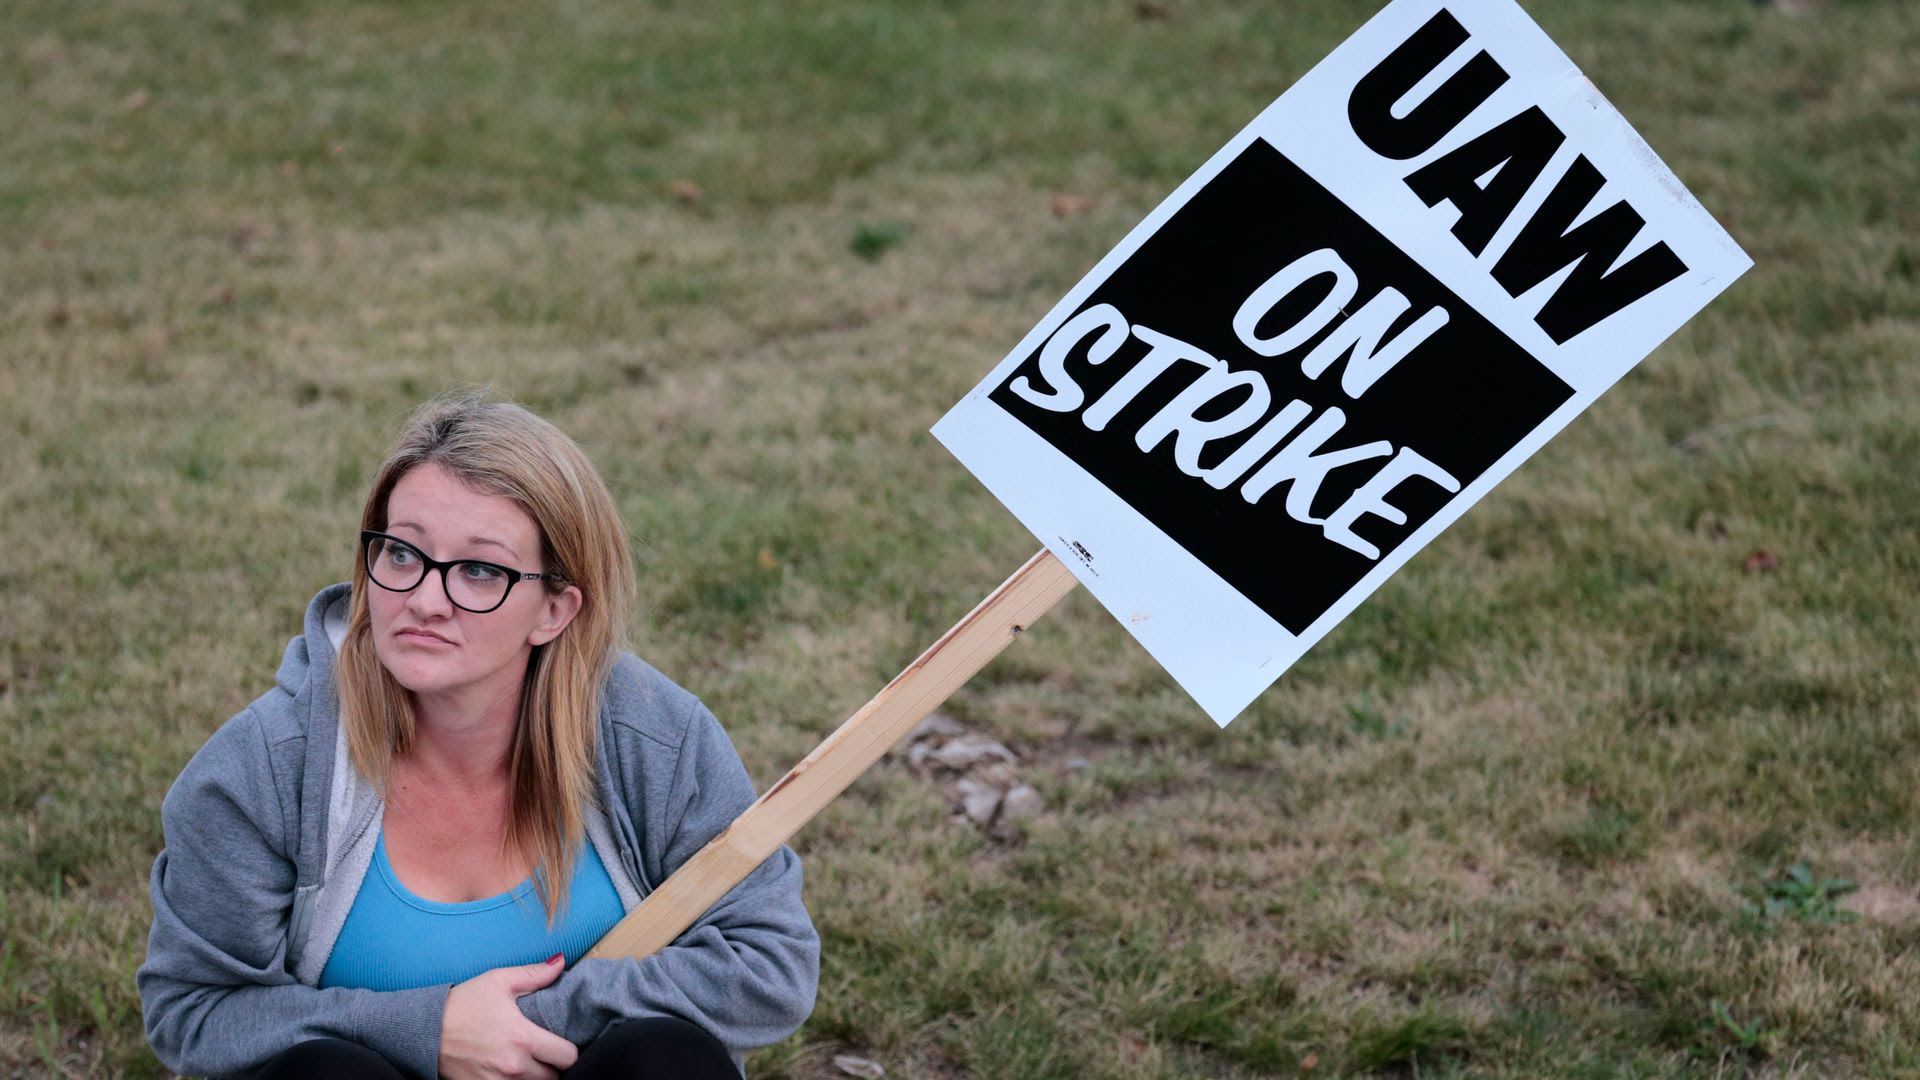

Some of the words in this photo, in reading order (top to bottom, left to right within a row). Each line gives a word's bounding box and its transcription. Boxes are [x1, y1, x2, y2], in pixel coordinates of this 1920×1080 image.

[1348, 8, 1689, 345] UAW
[1010, 304, 1460, 560] STRIKE
[1233, 248, 1449, 399] ON
